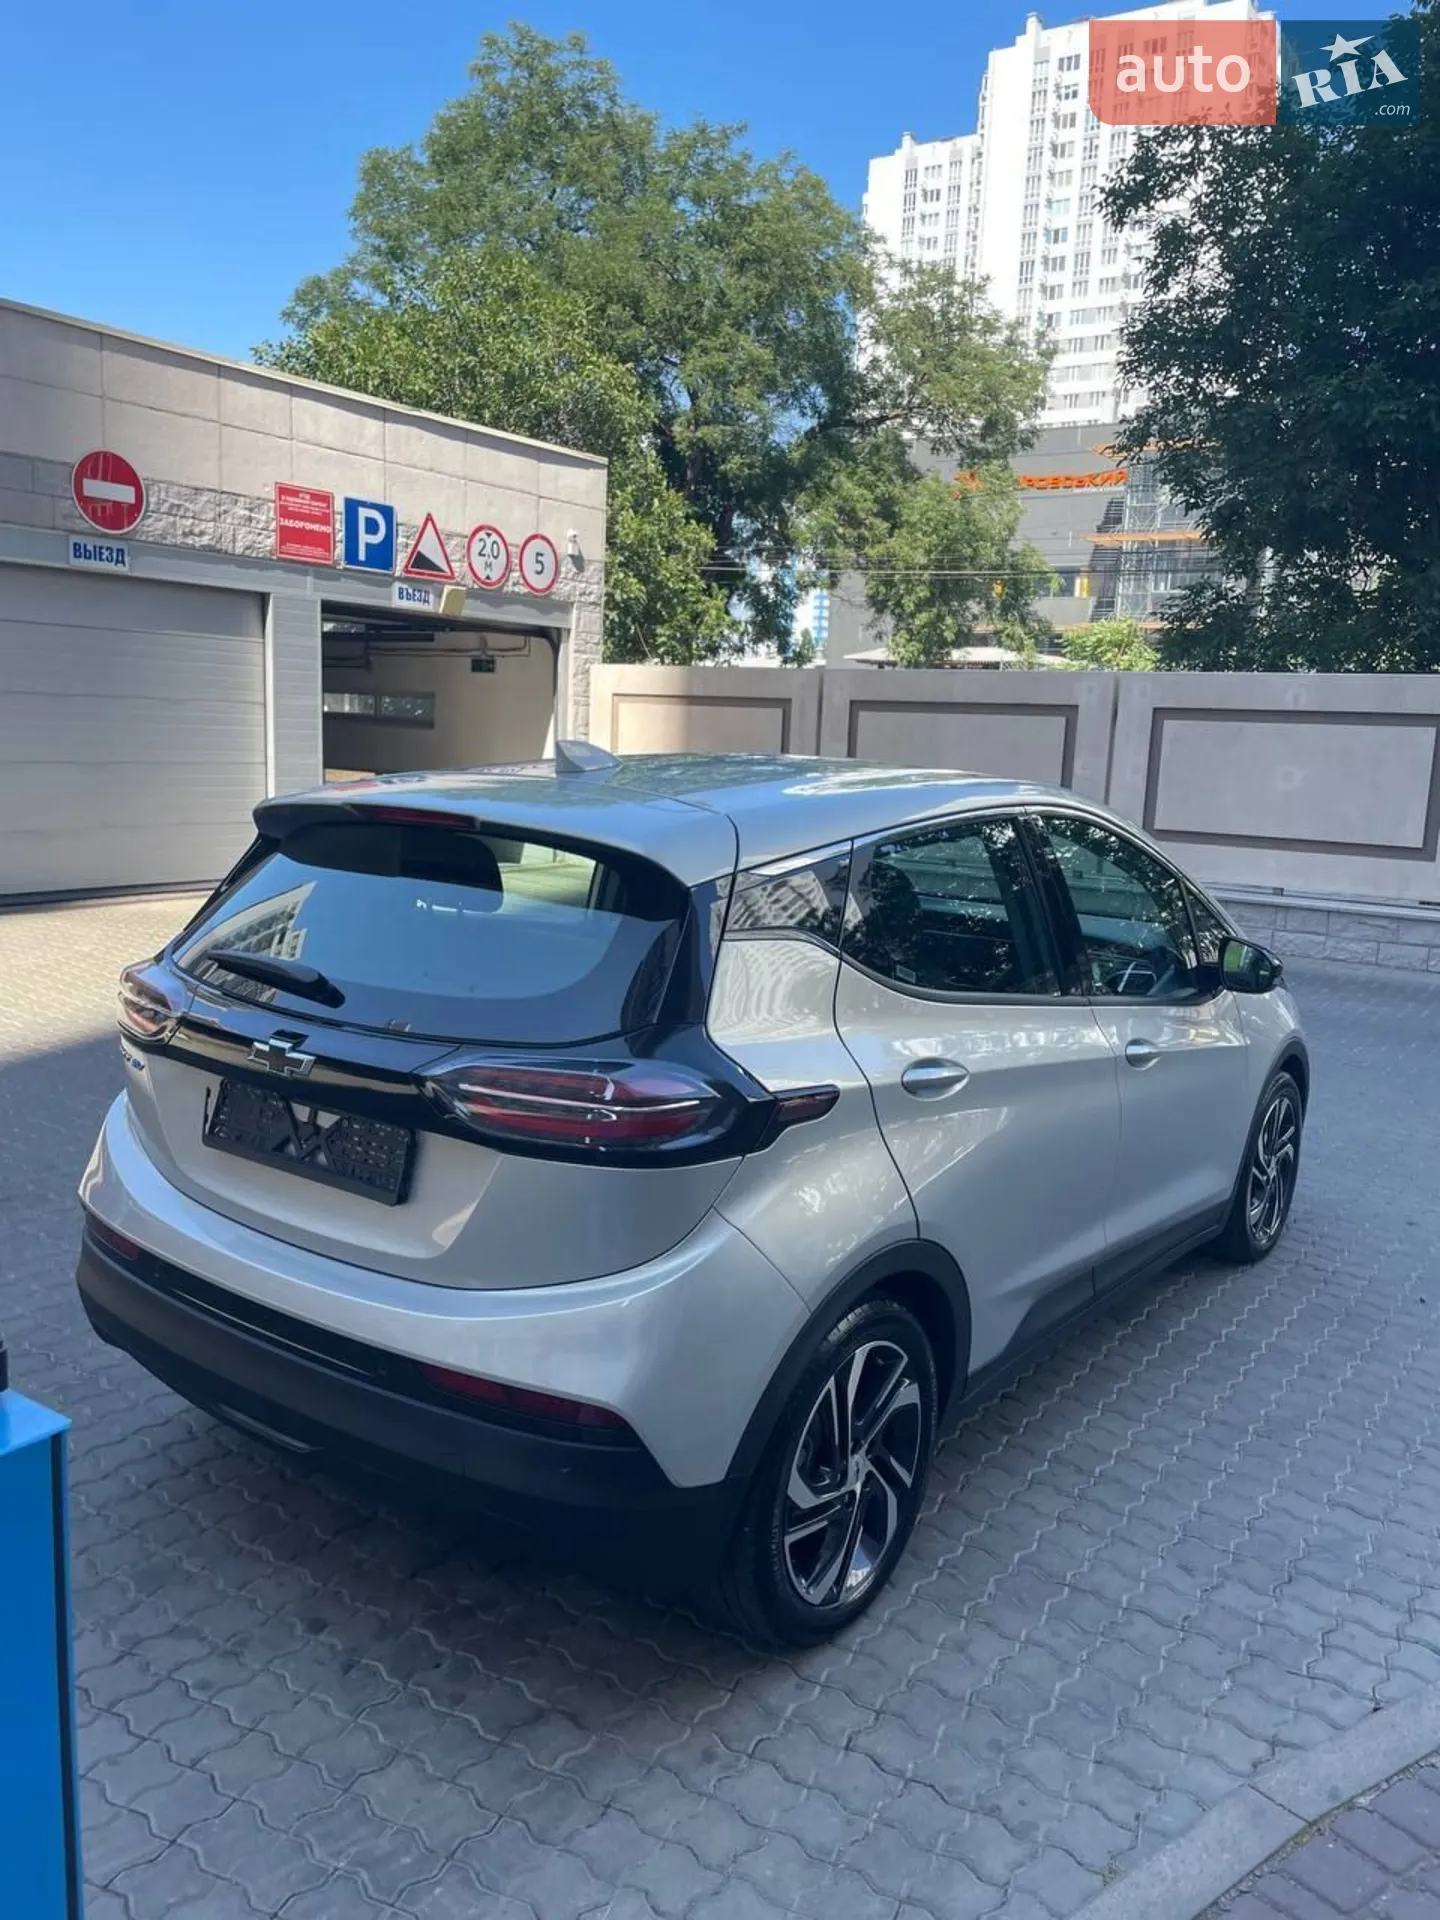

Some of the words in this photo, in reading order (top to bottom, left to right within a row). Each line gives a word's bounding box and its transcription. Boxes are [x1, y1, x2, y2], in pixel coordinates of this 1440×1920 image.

[358, 506, 386, 561] P
[73, 541, 126, 567] ВЫЕЗД
[534, 551, 545, 575] 5
[398, 587, 430, 606] ВЪЕЗД
